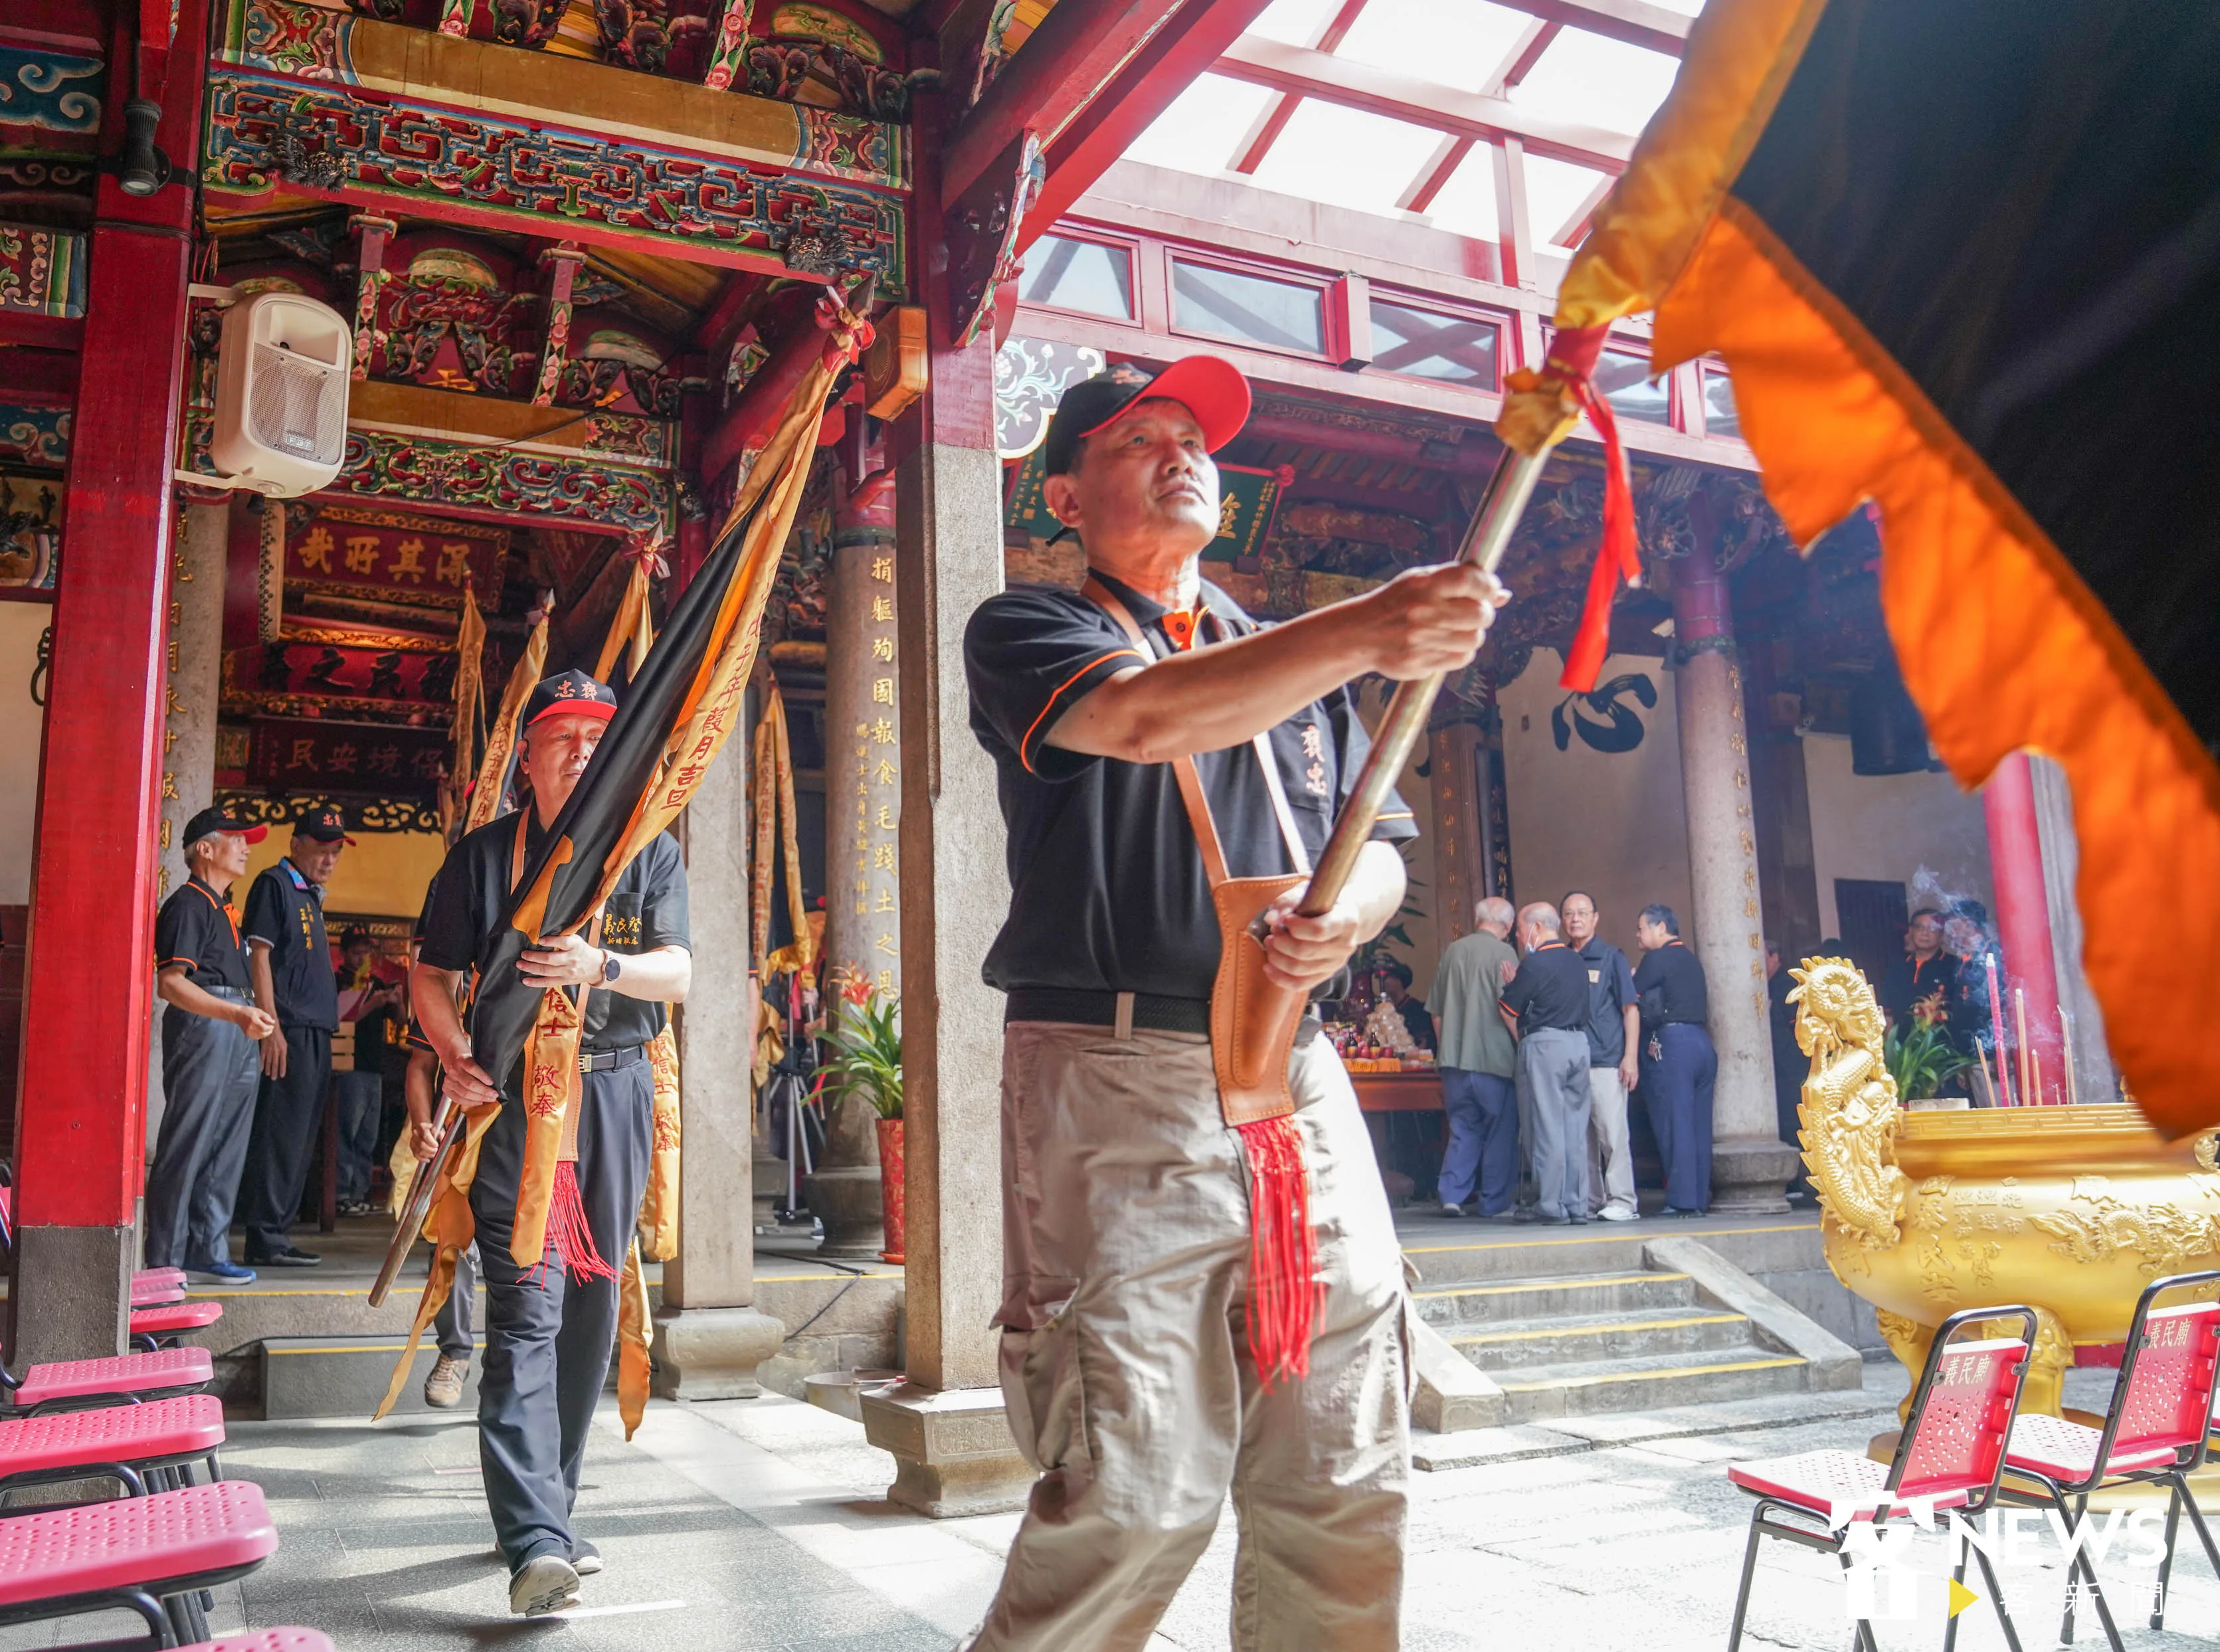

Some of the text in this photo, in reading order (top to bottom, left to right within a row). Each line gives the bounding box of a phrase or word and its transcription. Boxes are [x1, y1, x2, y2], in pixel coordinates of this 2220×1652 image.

[289, 436, 312, 448] FBT
[603, 913, 642, 936] 義民祭
[530, 987, 569, 1119] 信士 敬奉
[655, 1113, 676, 1152] 敬奉
[2148, 1317, 2190, 1350] 義民廟
[1944, 1354, 1990, 1387] 義民廟
